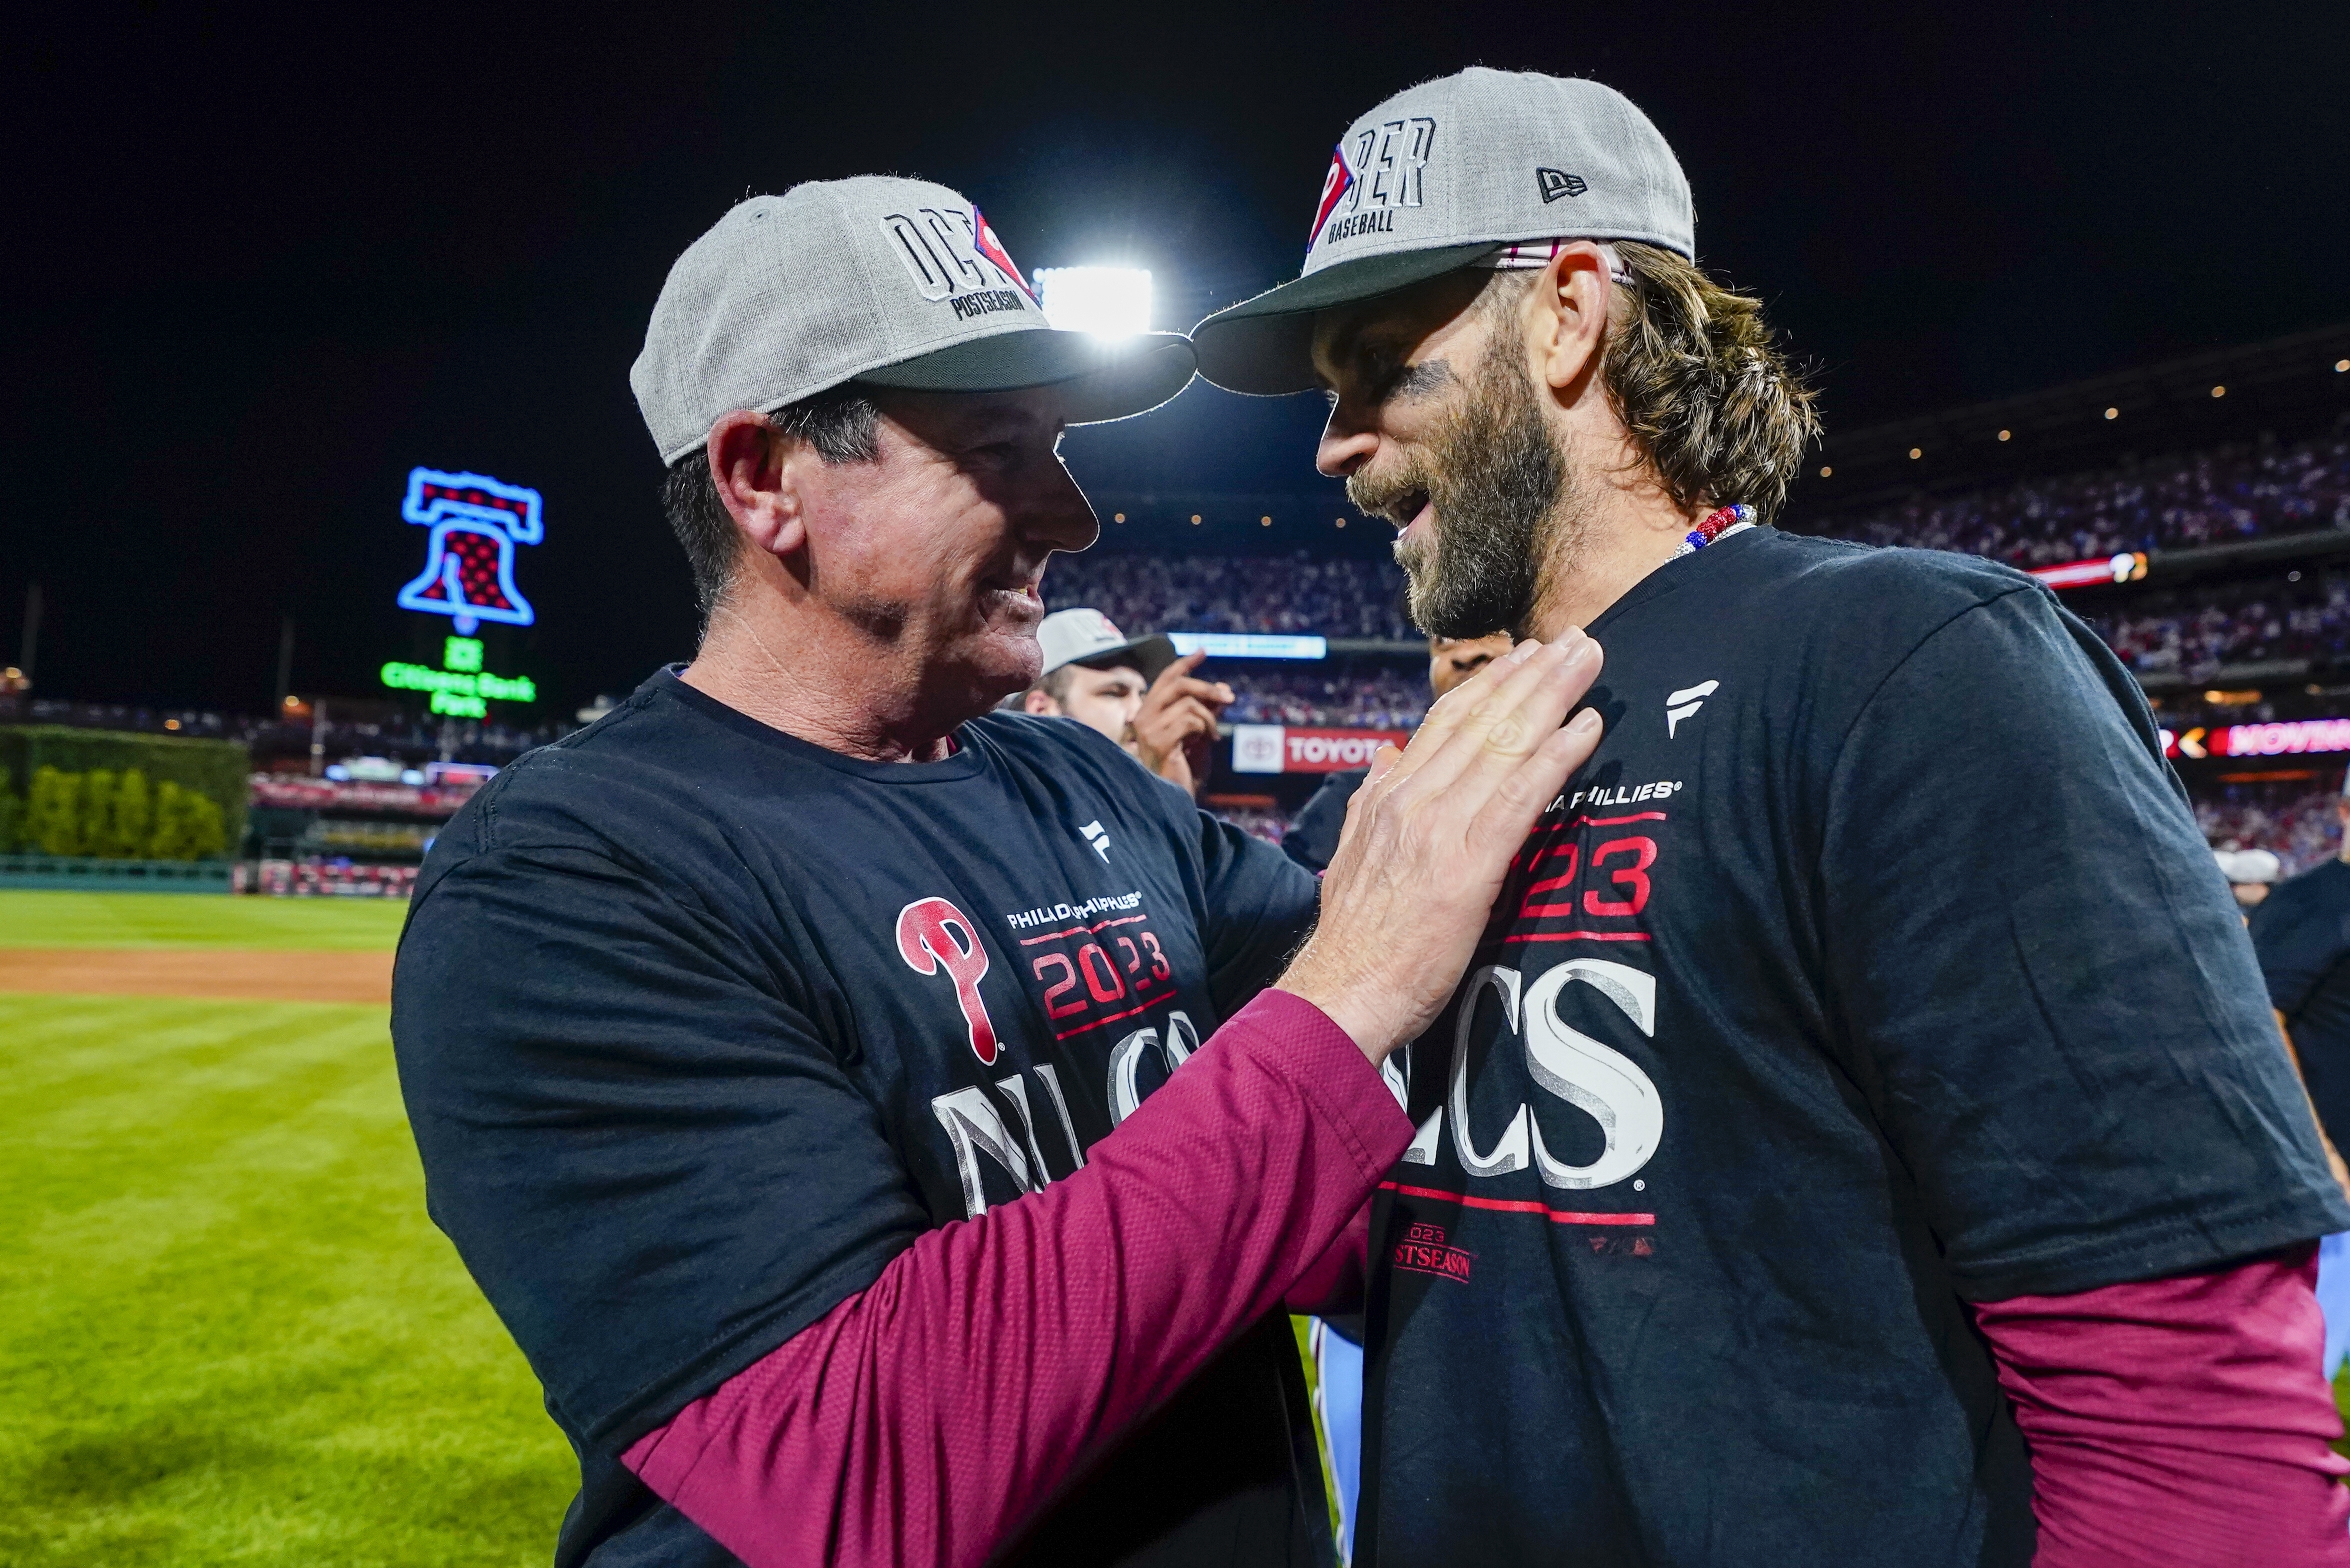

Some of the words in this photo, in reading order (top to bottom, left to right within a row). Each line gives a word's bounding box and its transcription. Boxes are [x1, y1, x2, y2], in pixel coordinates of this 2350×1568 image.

[1328, 210, 1393, 245] BASEBALL
[950, 289, 1025, 322] POSTSEASON
[1406, 1227, 1445, 1243] 023
